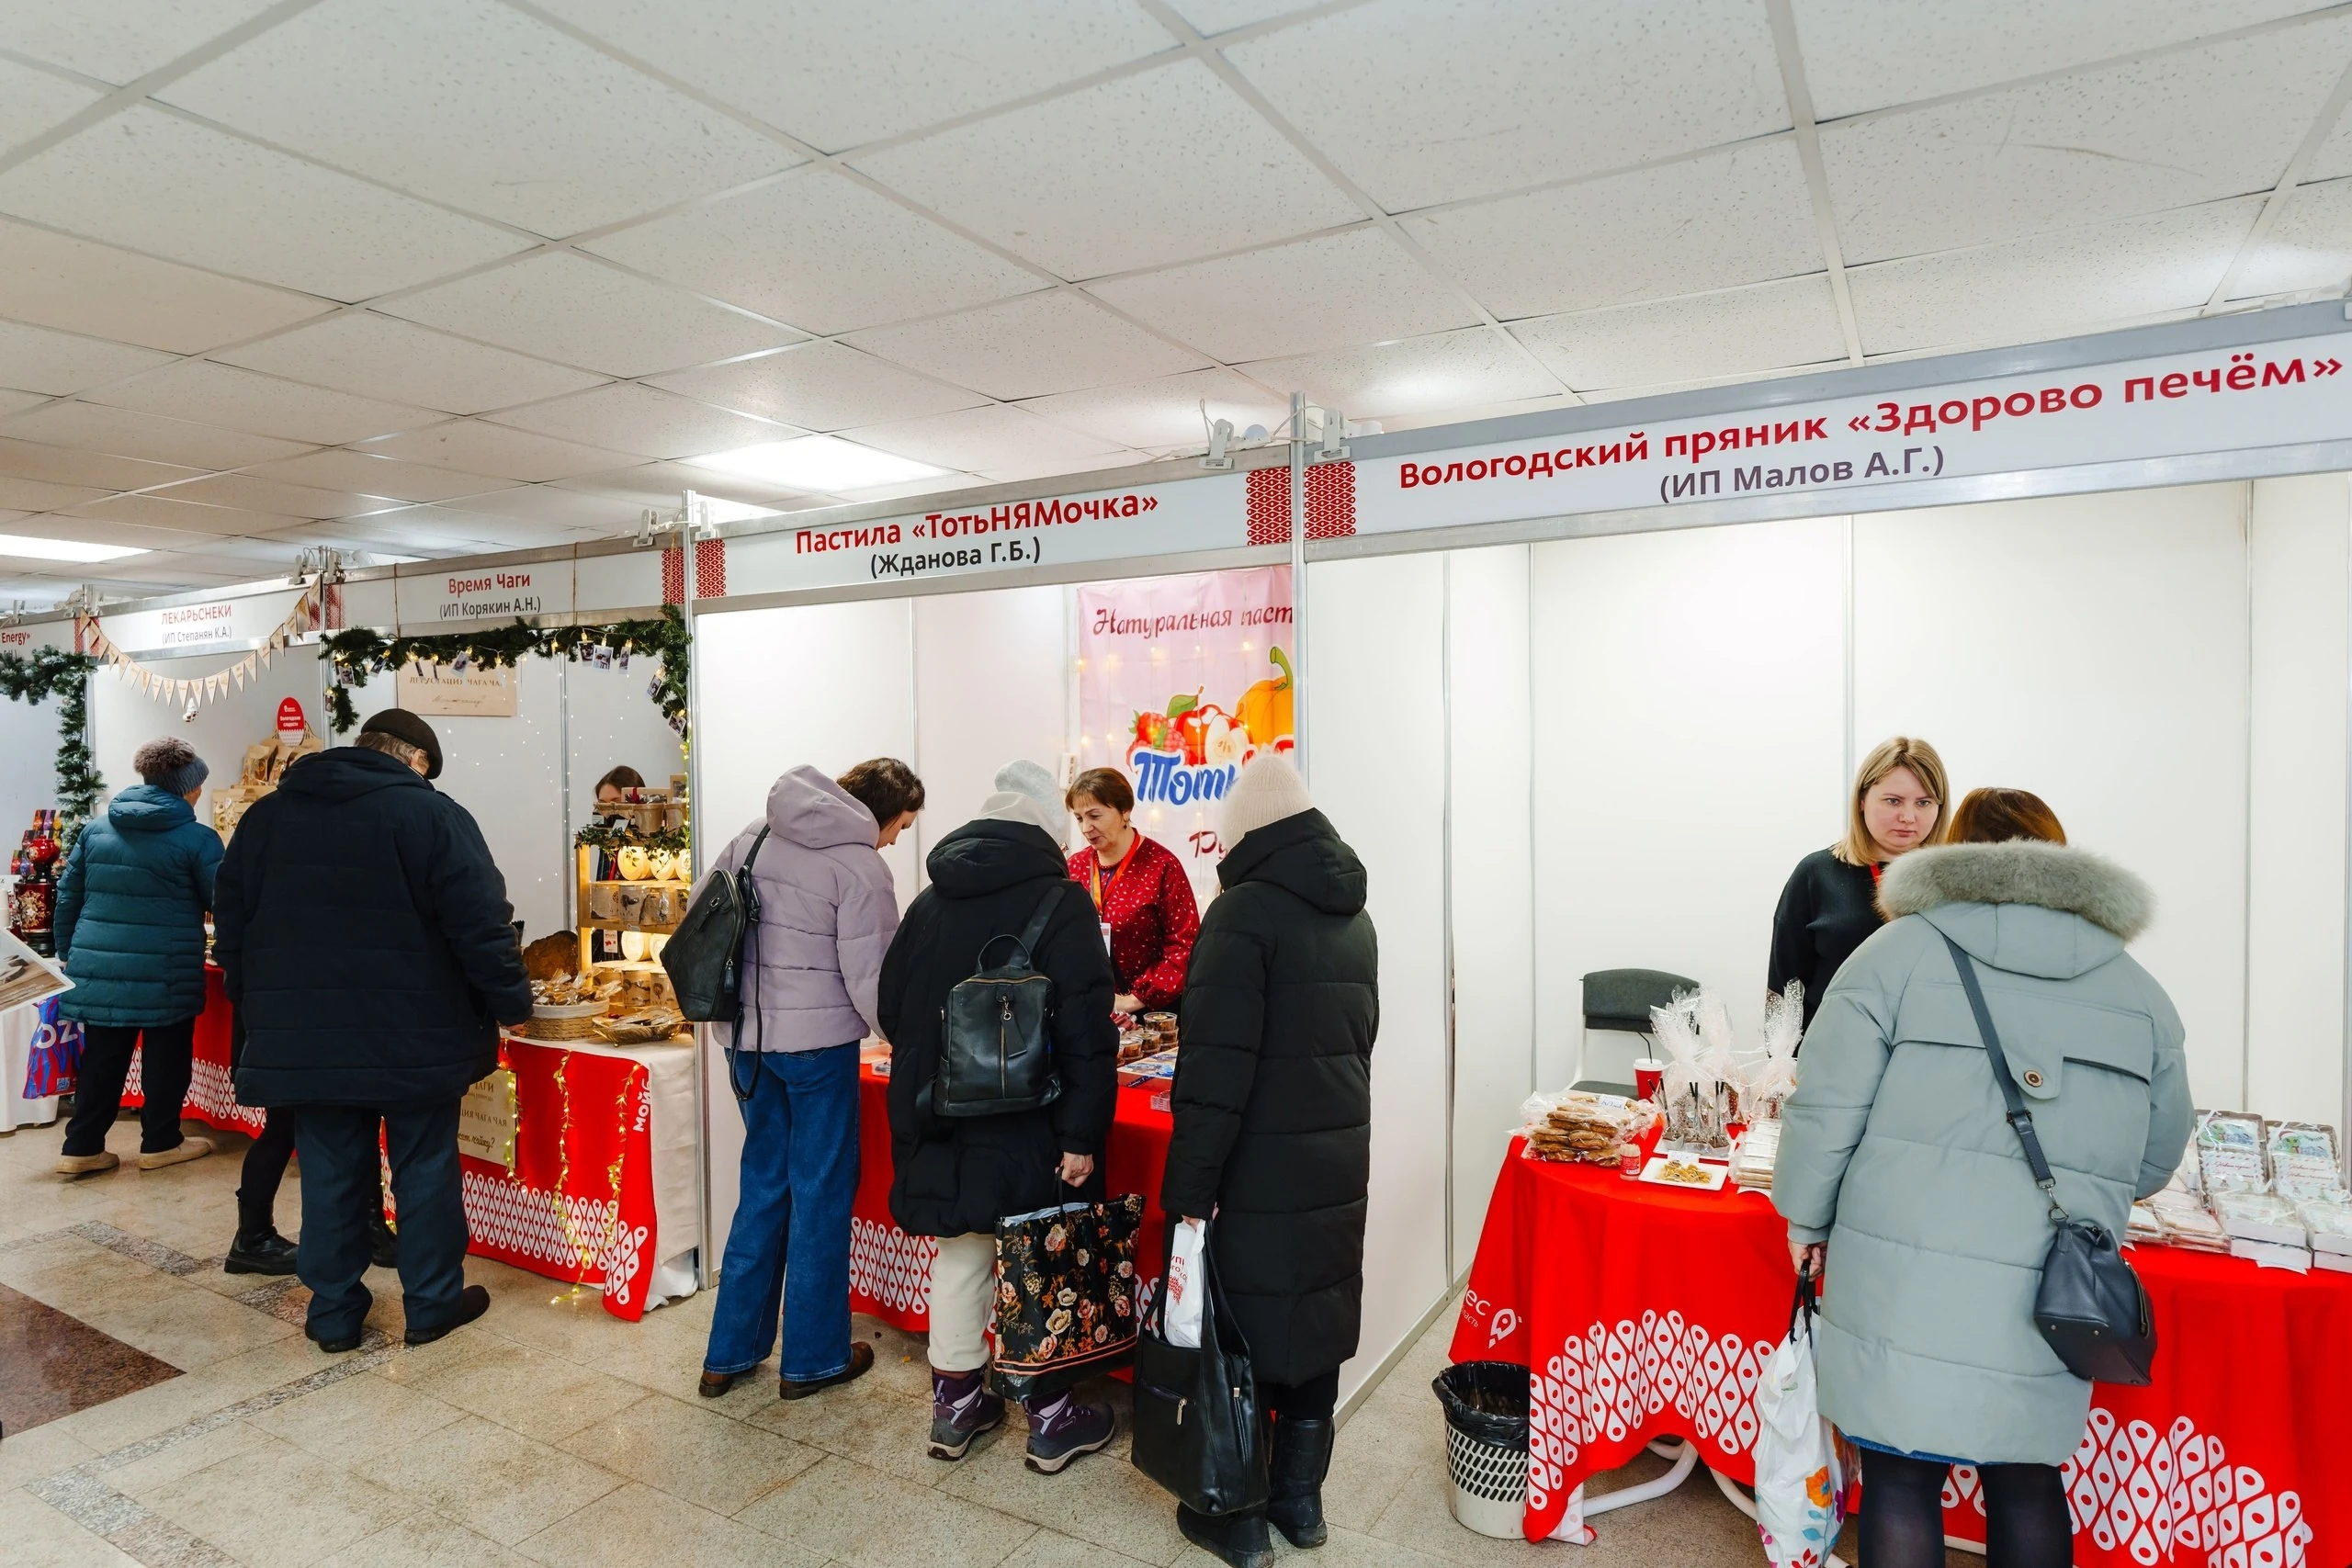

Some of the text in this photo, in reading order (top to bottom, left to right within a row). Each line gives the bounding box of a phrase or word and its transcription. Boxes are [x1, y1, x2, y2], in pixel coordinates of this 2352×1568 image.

[1400, 352, 2343, 489] Вологодский пряник «Здорово печём»
[1660, 446, 1945, 503] (ИП Малов А.Г.)
[796, 494, 1159, 554] Пастила «ТотьНЯМочка»
[871, 536, 1041, 579] (Жданова Г.Б.)
[448, 573, 530, 599] Время Чаги
[161, 604, 232, 626] ЛЕКАРЬСНЕКИ
[439, 596, 541, 620] (ИП Корякин А.Н.)
[162, 626, 232, 645] (ИП Степанян К.А.)
[1092, 608, 1232, 639] Натуральная
[1, 632, 30, 646] Energy»
[36, 1020, 85, 1049] OZ
